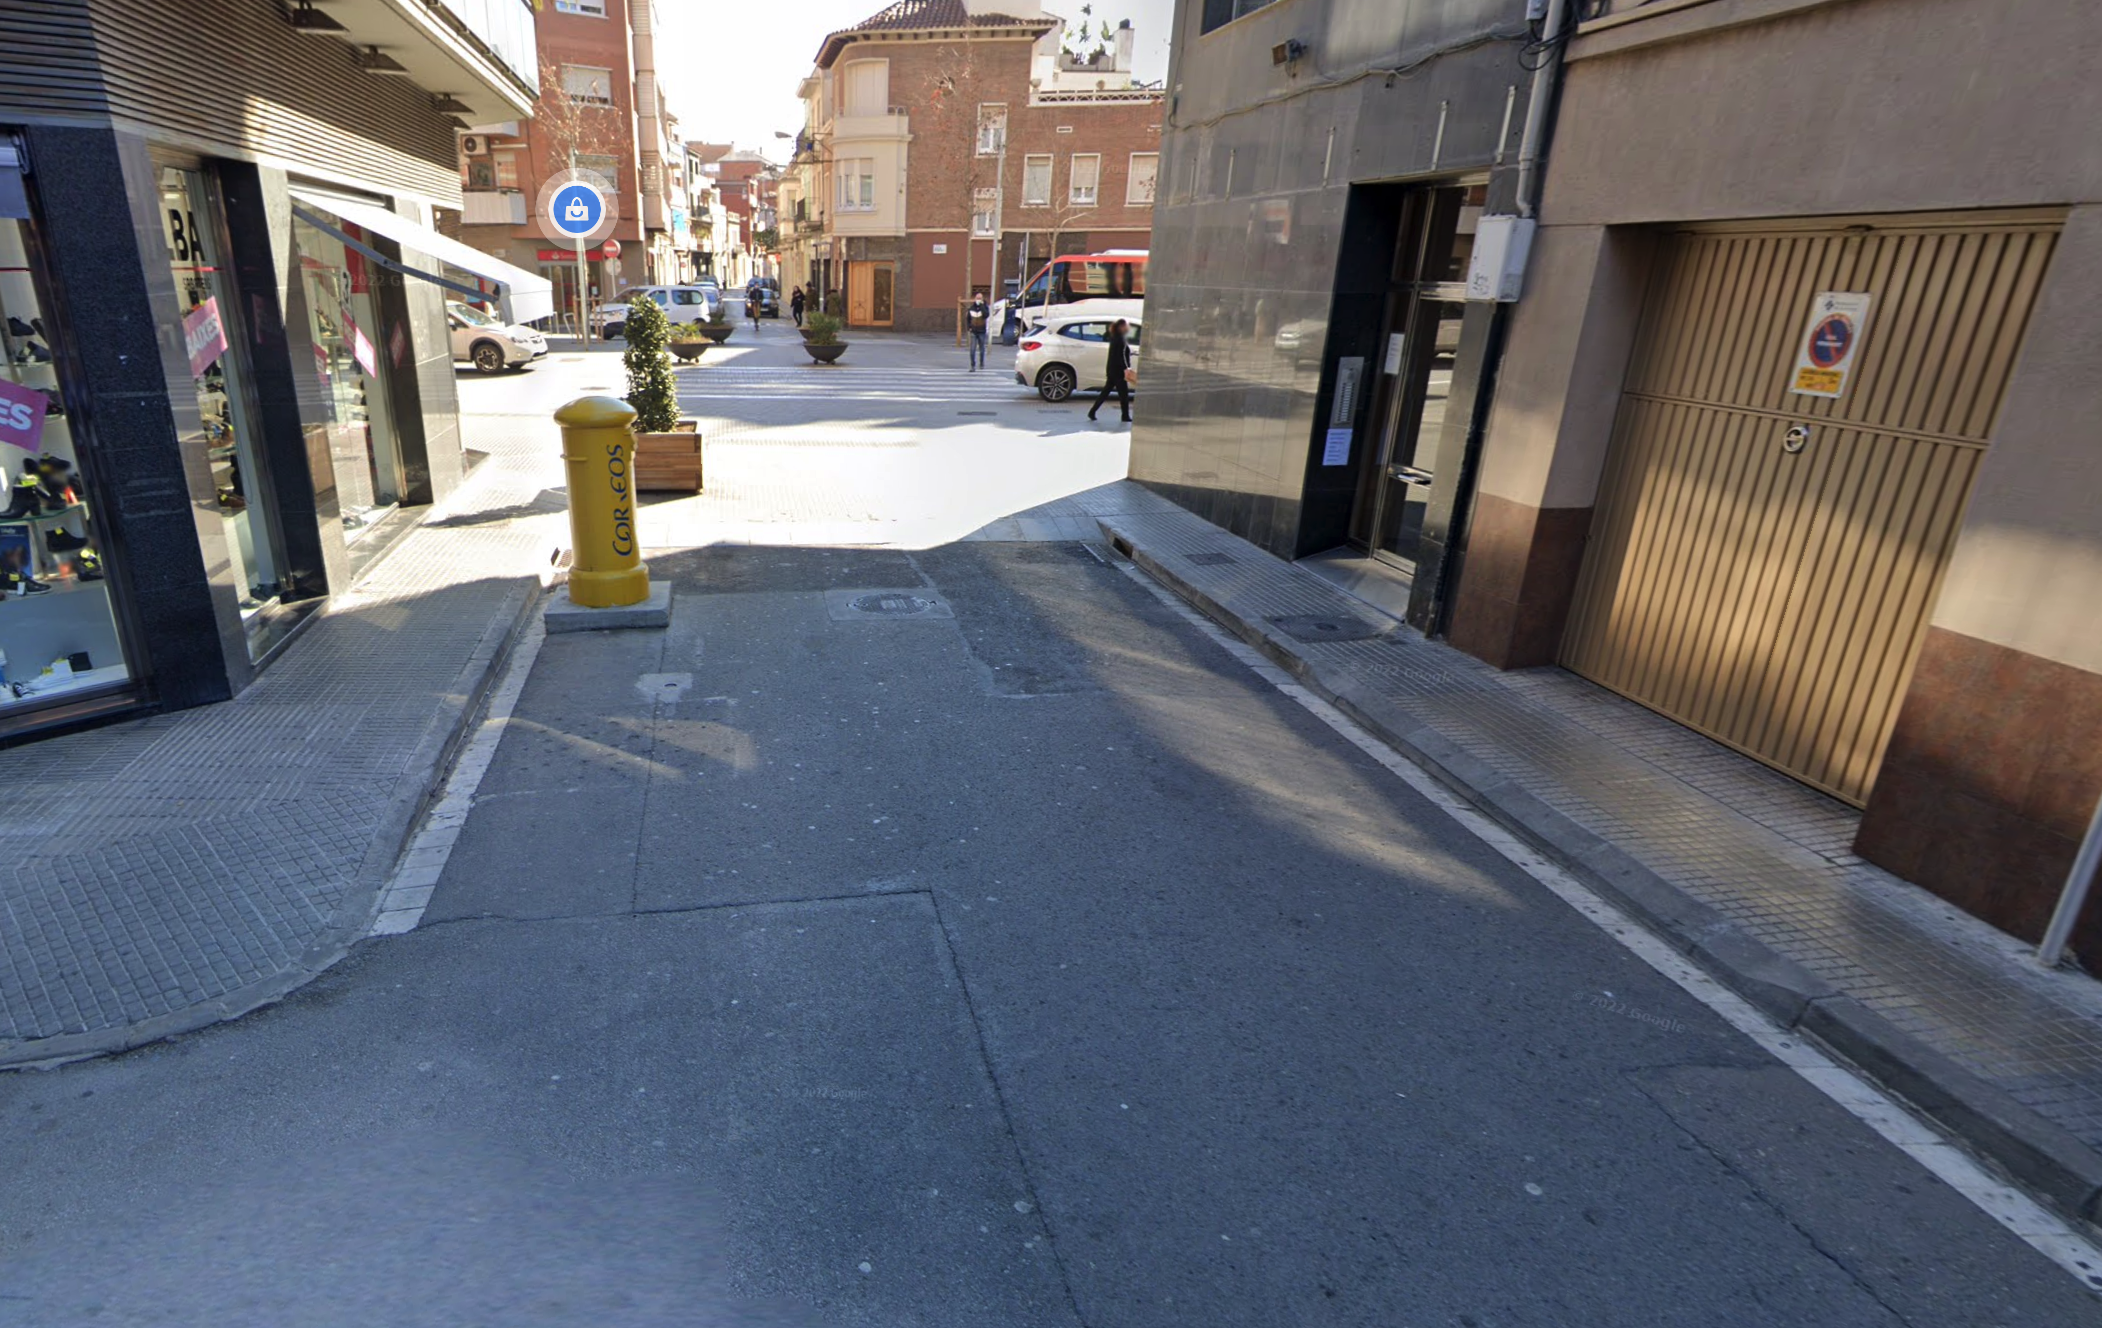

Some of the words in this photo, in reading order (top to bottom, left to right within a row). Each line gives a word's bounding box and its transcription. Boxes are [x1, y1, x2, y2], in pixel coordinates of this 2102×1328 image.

[168, 209, 206, 261] BA
[186, 313, 220, 360] BAIXES
[607, 444, 634, 556] COREOS
